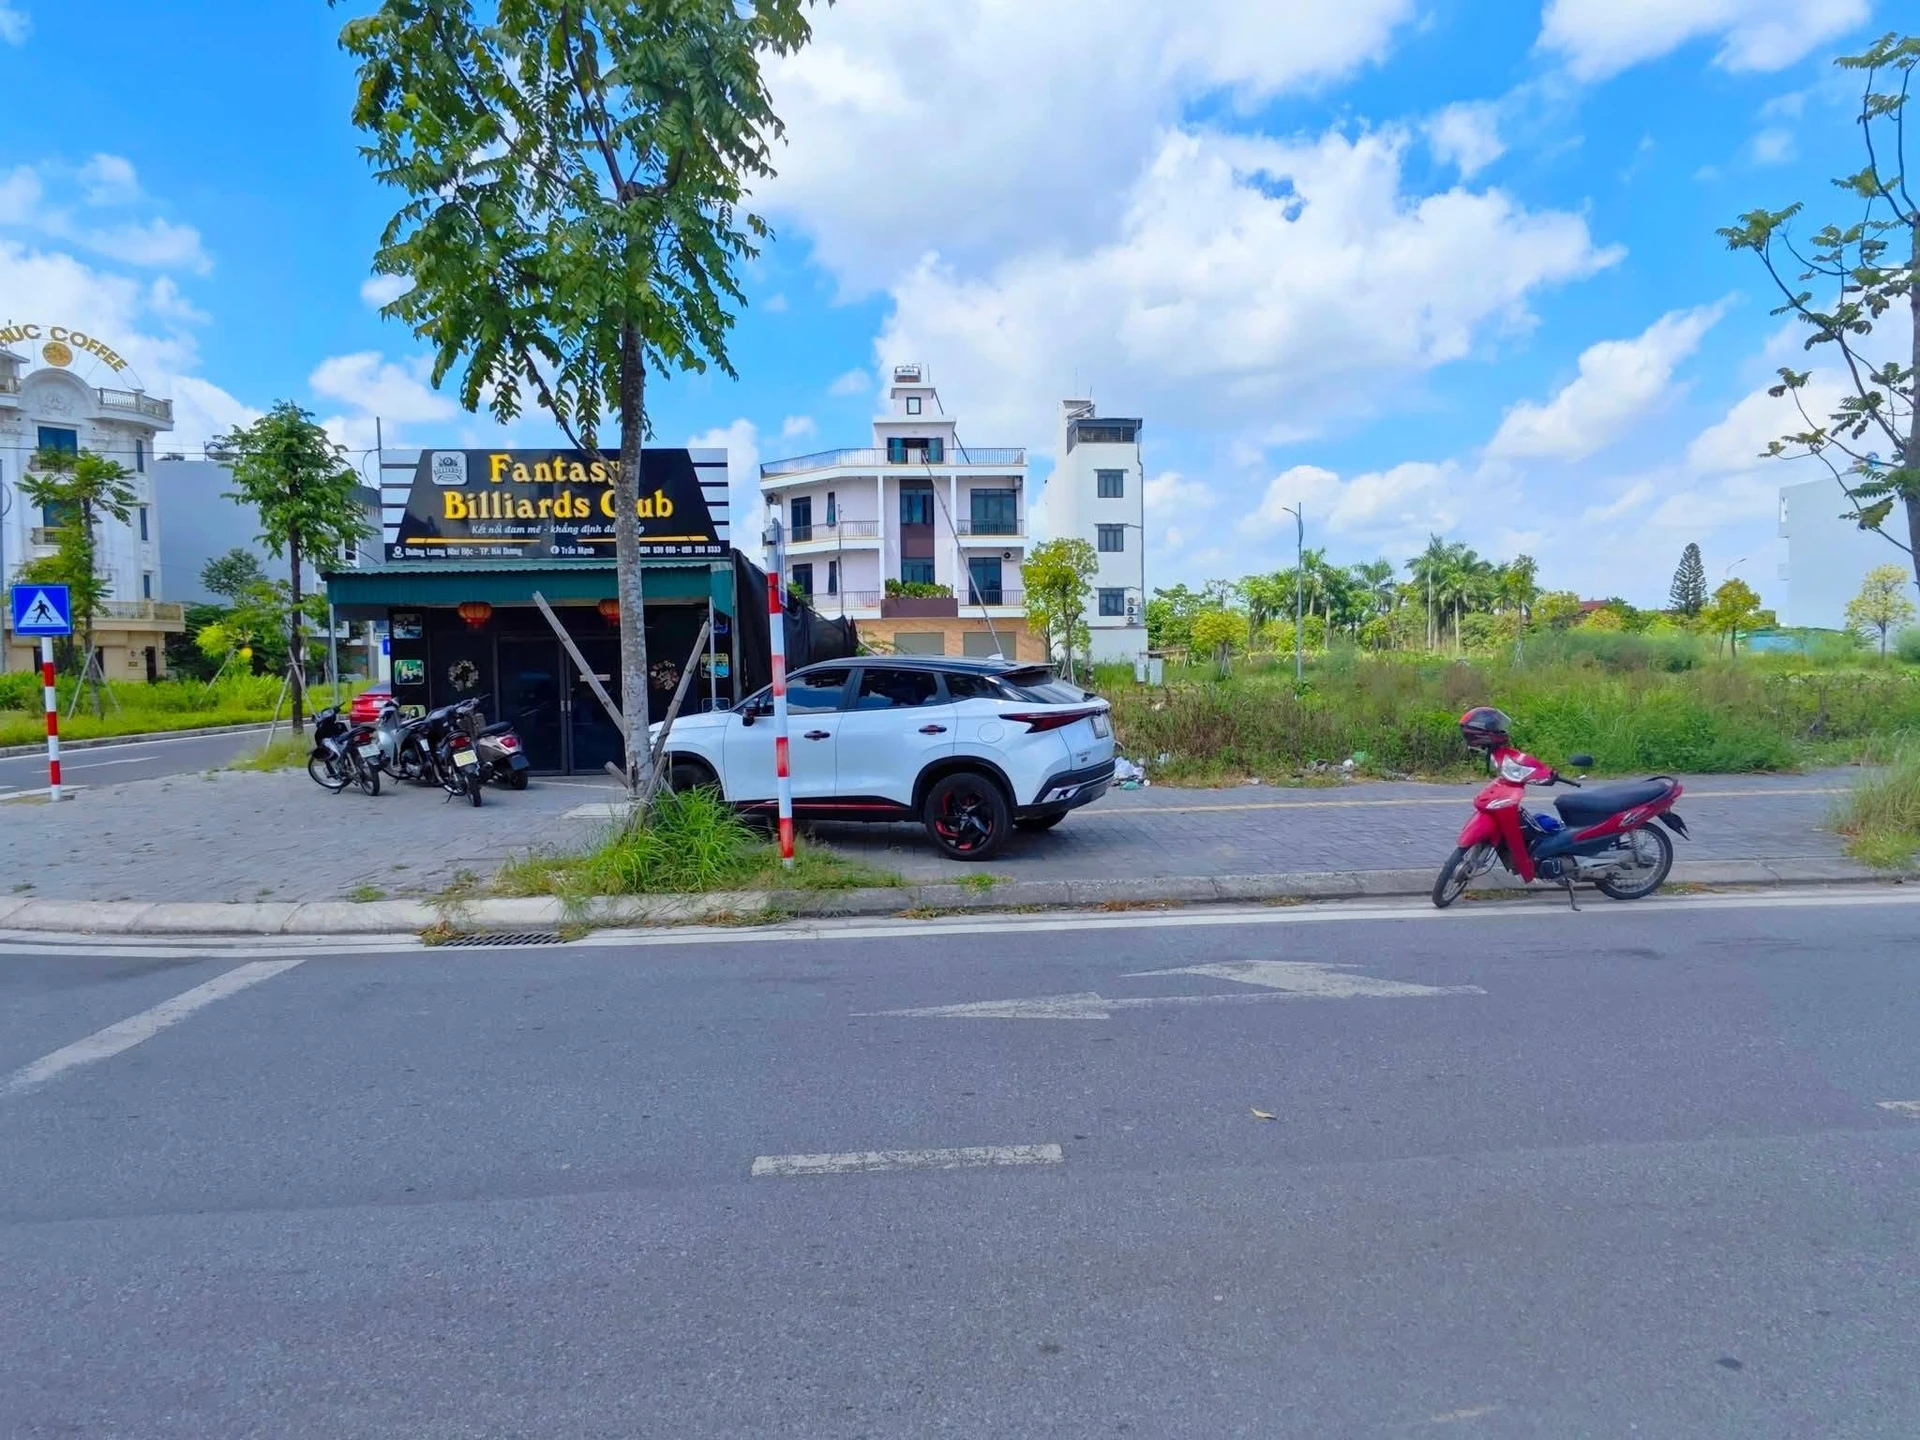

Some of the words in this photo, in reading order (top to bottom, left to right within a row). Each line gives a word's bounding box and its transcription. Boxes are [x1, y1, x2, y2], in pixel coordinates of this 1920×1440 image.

[50, 326, 128, 373] COFFEE
[443, 490, 590, 519] Billiards
[600, 489, 673, 518] Cub
